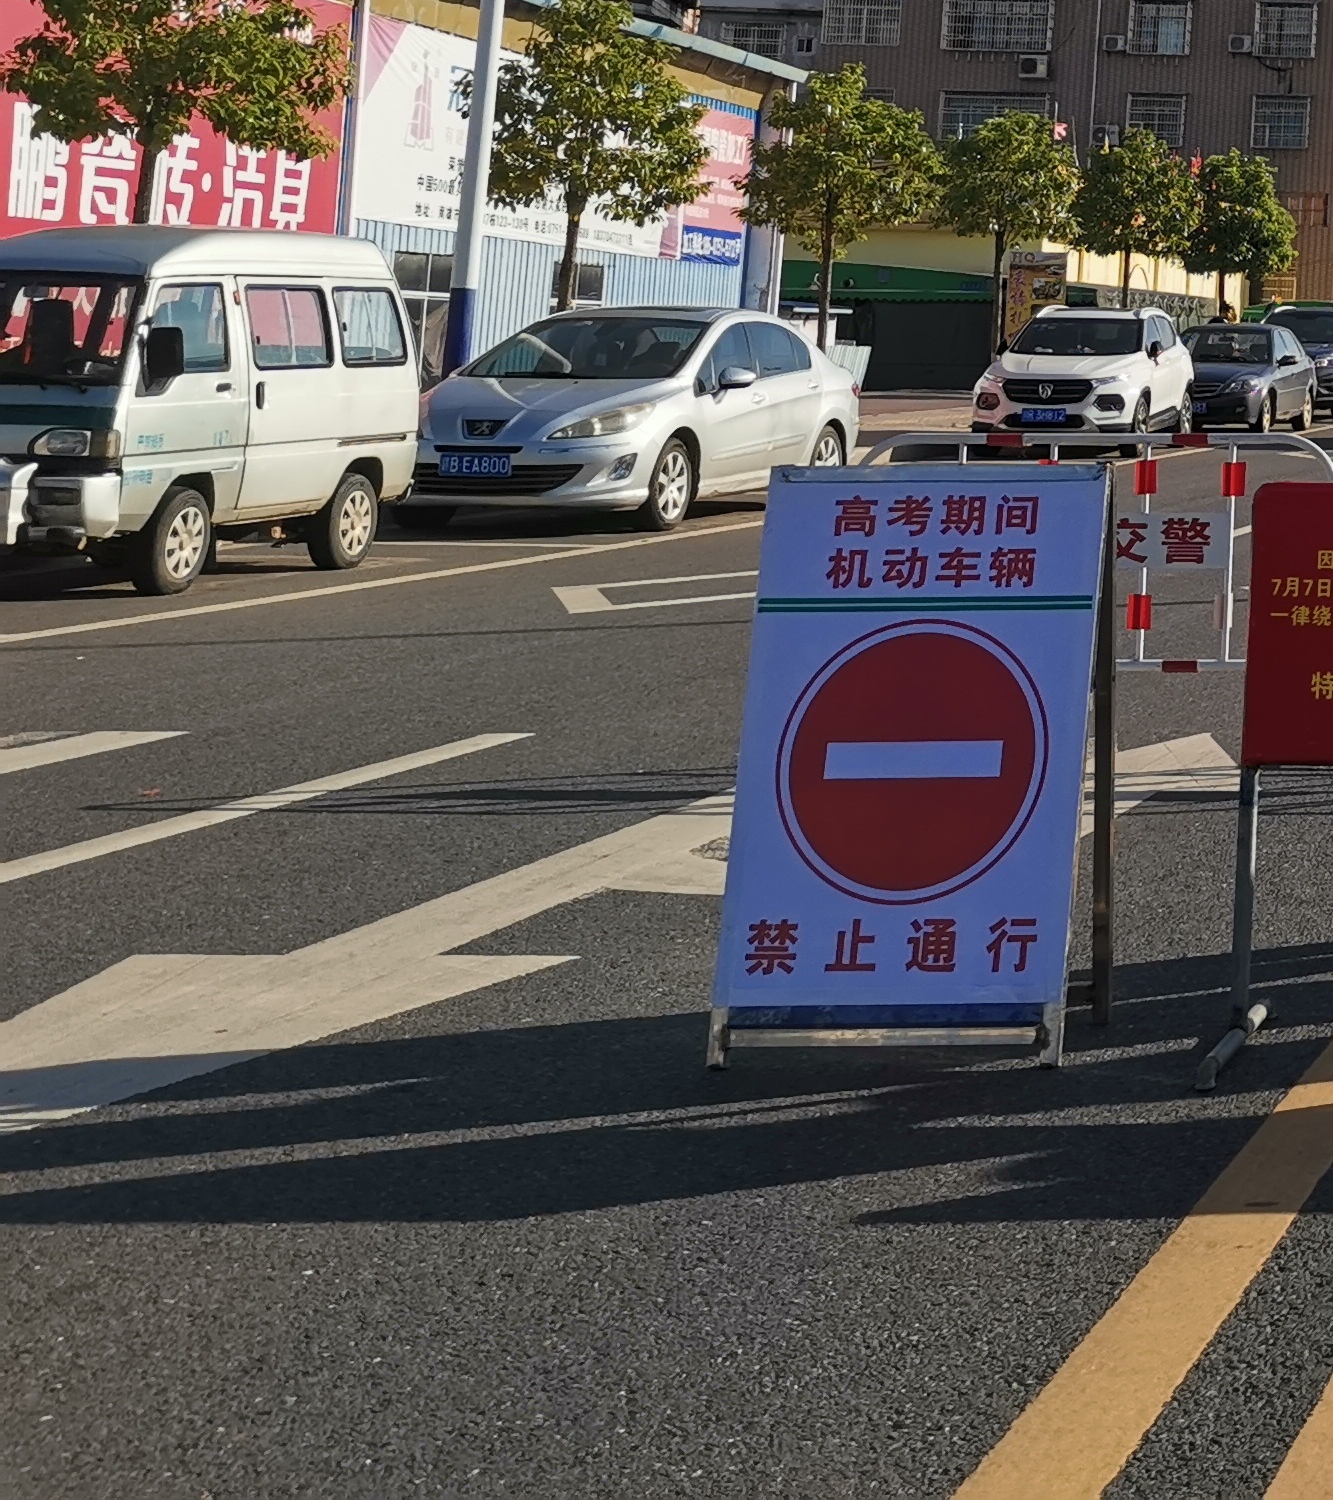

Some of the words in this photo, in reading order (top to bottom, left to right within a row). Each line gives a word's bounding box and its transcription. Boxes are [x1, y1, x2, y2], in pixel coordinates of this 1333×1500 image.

[833, 495, 1040, 538] 高考期间
[1116, 518, 1211, 564] 交警
[826, 546, 1037, 589] 机动车辆
[745, 916, 1038, 974] 禁止通行
